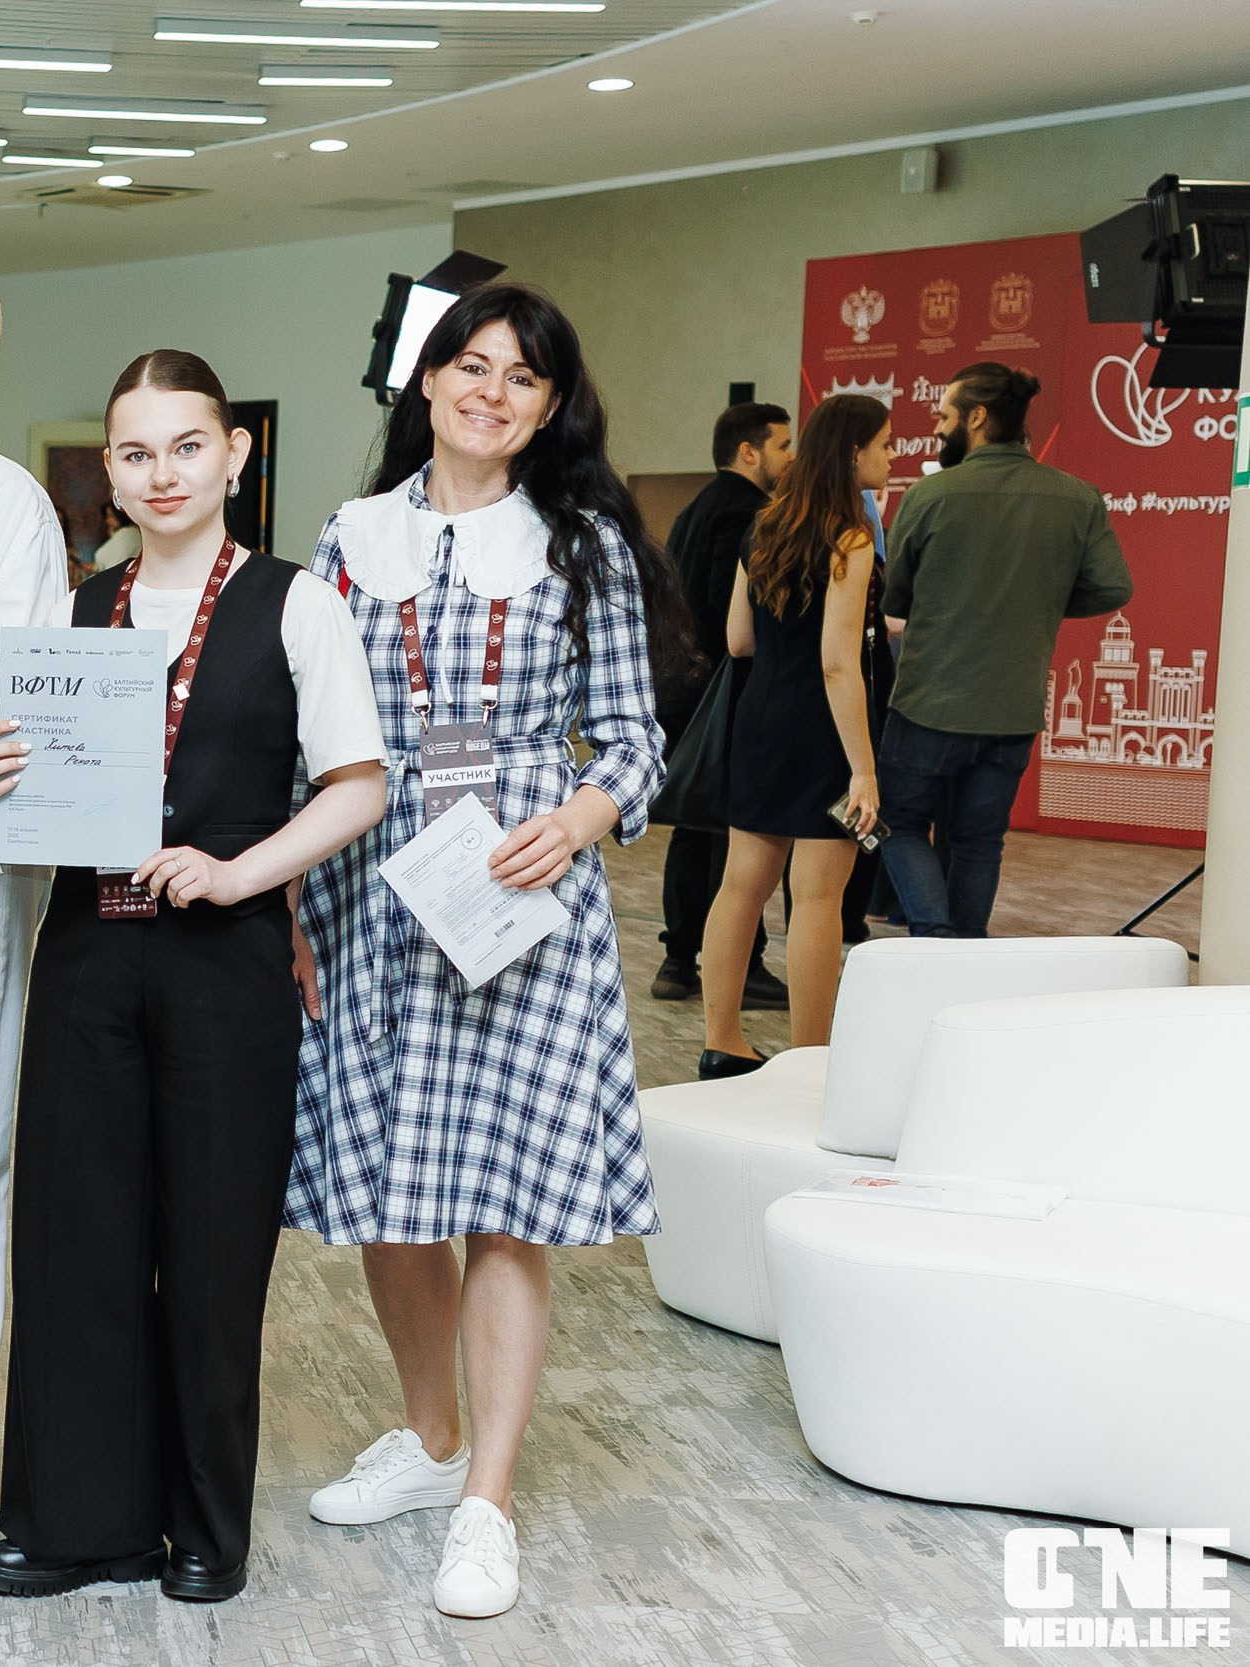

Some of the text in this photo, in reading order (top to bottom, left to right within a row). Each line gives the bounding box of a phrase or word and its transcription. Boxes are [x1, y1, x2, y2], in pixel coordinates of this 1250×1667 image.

[9, 675, 86, 697] ВФТМ
[11, 714, 79, 724] СЕРТИФИКАТ
[16, 727, 72, 736] ЧАСТНИКА
[428, 769, 492, 783] УЧАСТНИК
